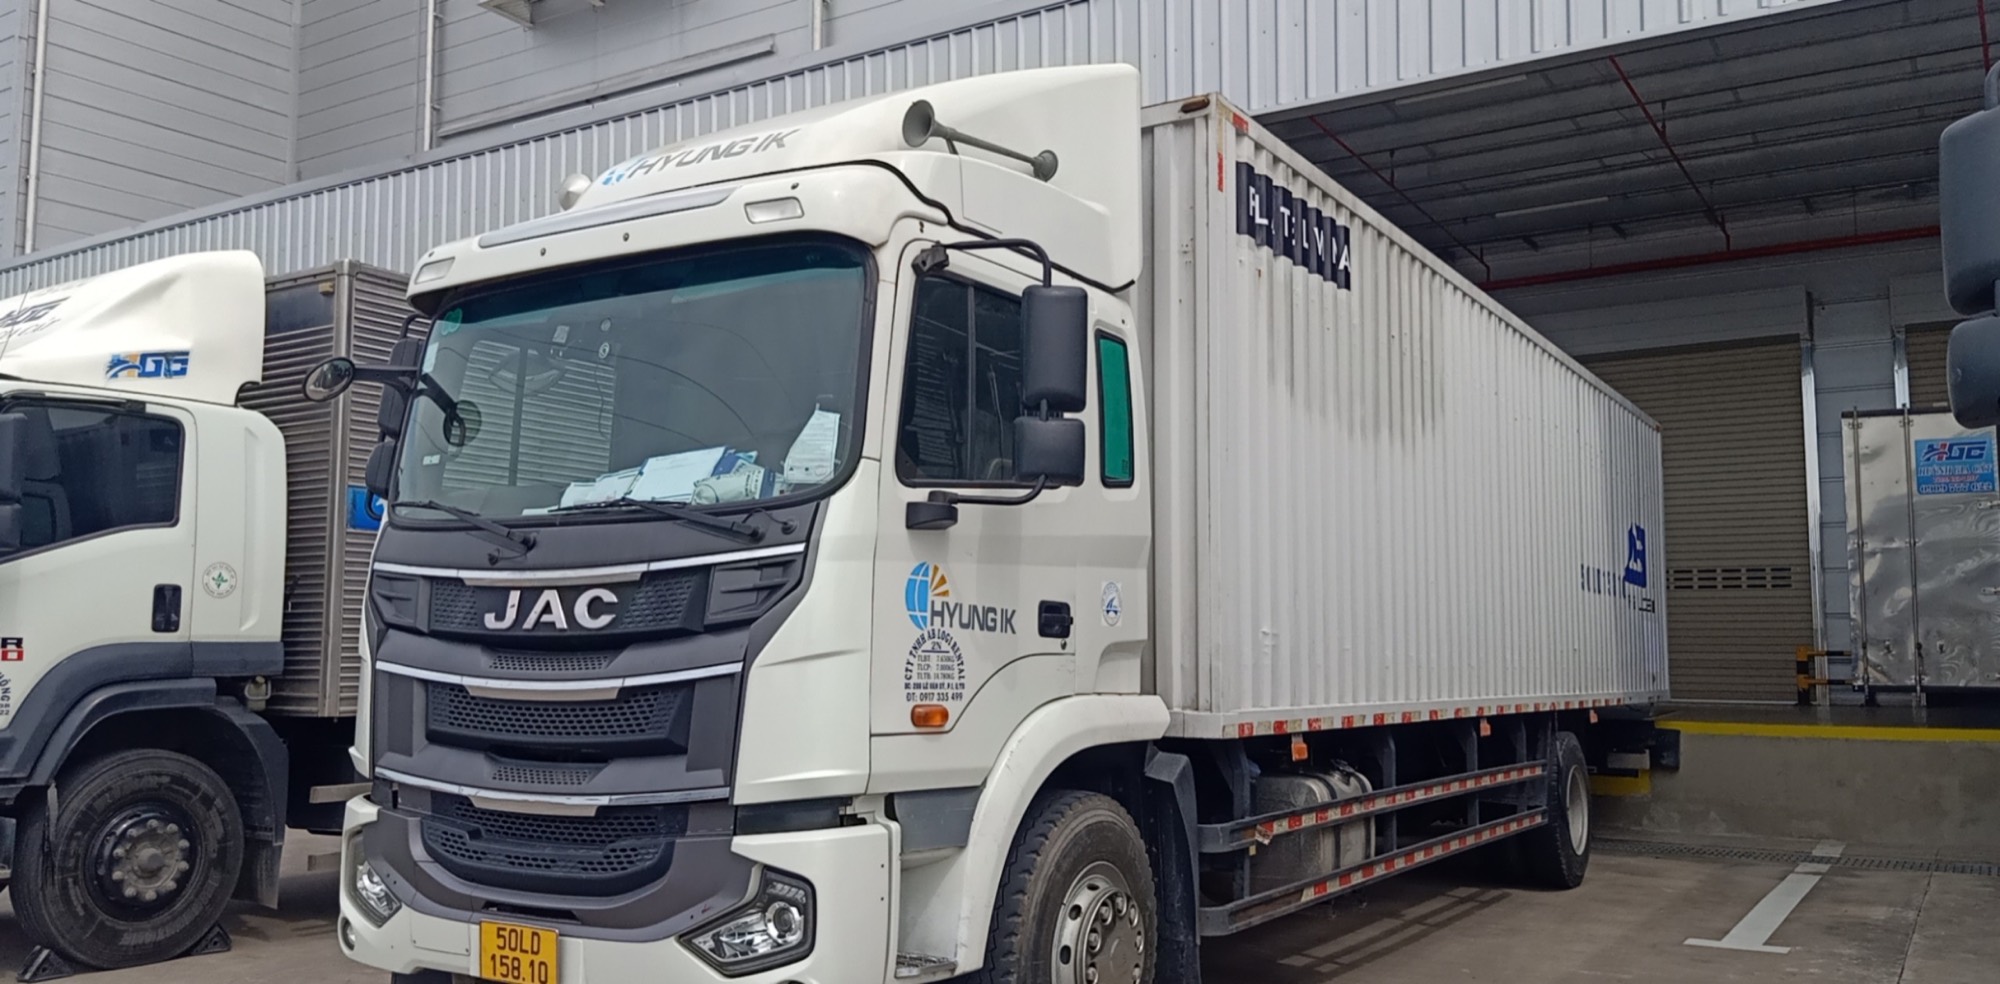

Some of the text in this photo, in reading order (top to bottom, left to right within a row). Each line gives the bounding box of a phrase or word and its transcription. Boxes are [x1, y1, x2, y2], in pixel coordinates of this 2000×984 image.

[627, 128, 801, 179] HYUNG IK
[1922, 441, 1987, 462] HGC
[484, 588, 618, 630] JAC
[930, 600, 1017, 634] HYUNG IK
[904, 658, 914, 681] CTY
[909, 633, 927, 659] TNHH
[951, 641, 965, 681] RENTAL
[919, 691, 935, 702] 0917
[937, 691, 949, 702] 335
[951, 691, 963, 701] 499
[496, 926, 541, 956] 50LD
[490, 953, 548, 984] 158.10
